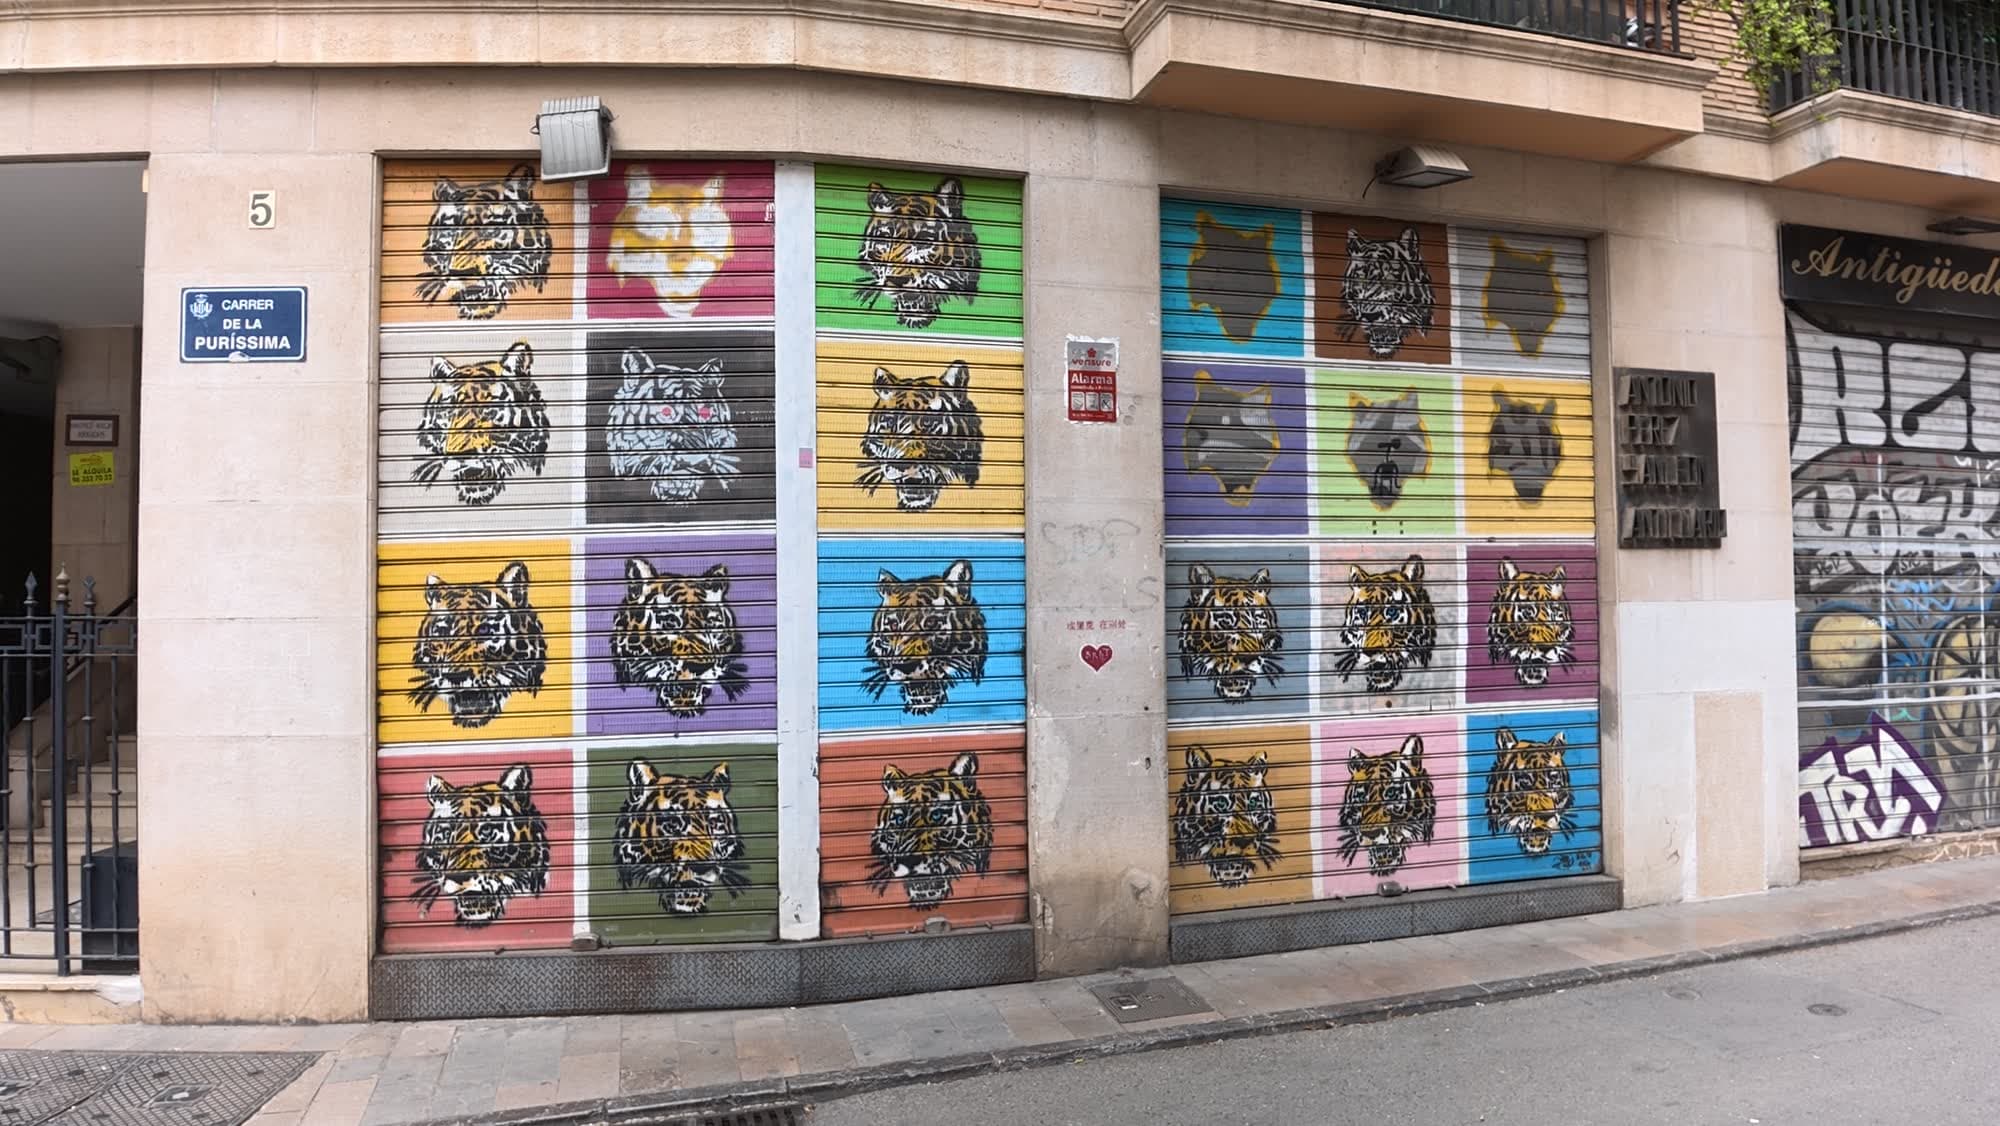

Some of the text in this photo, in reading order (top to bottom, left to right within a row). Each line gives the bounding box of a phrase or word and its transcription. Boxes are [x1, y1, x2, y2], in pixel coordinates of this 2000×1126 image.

[250, 193, 272, 227] 5
[1791, 236, 2000, 304] Antigüed
[221, 299, 274, 311] CARRER
[223, 318, 263, 330] DE LA
[194, 332, 292, 350] PURÍSSIMA
[1618, 375, 1697, 408] ANTONIO
